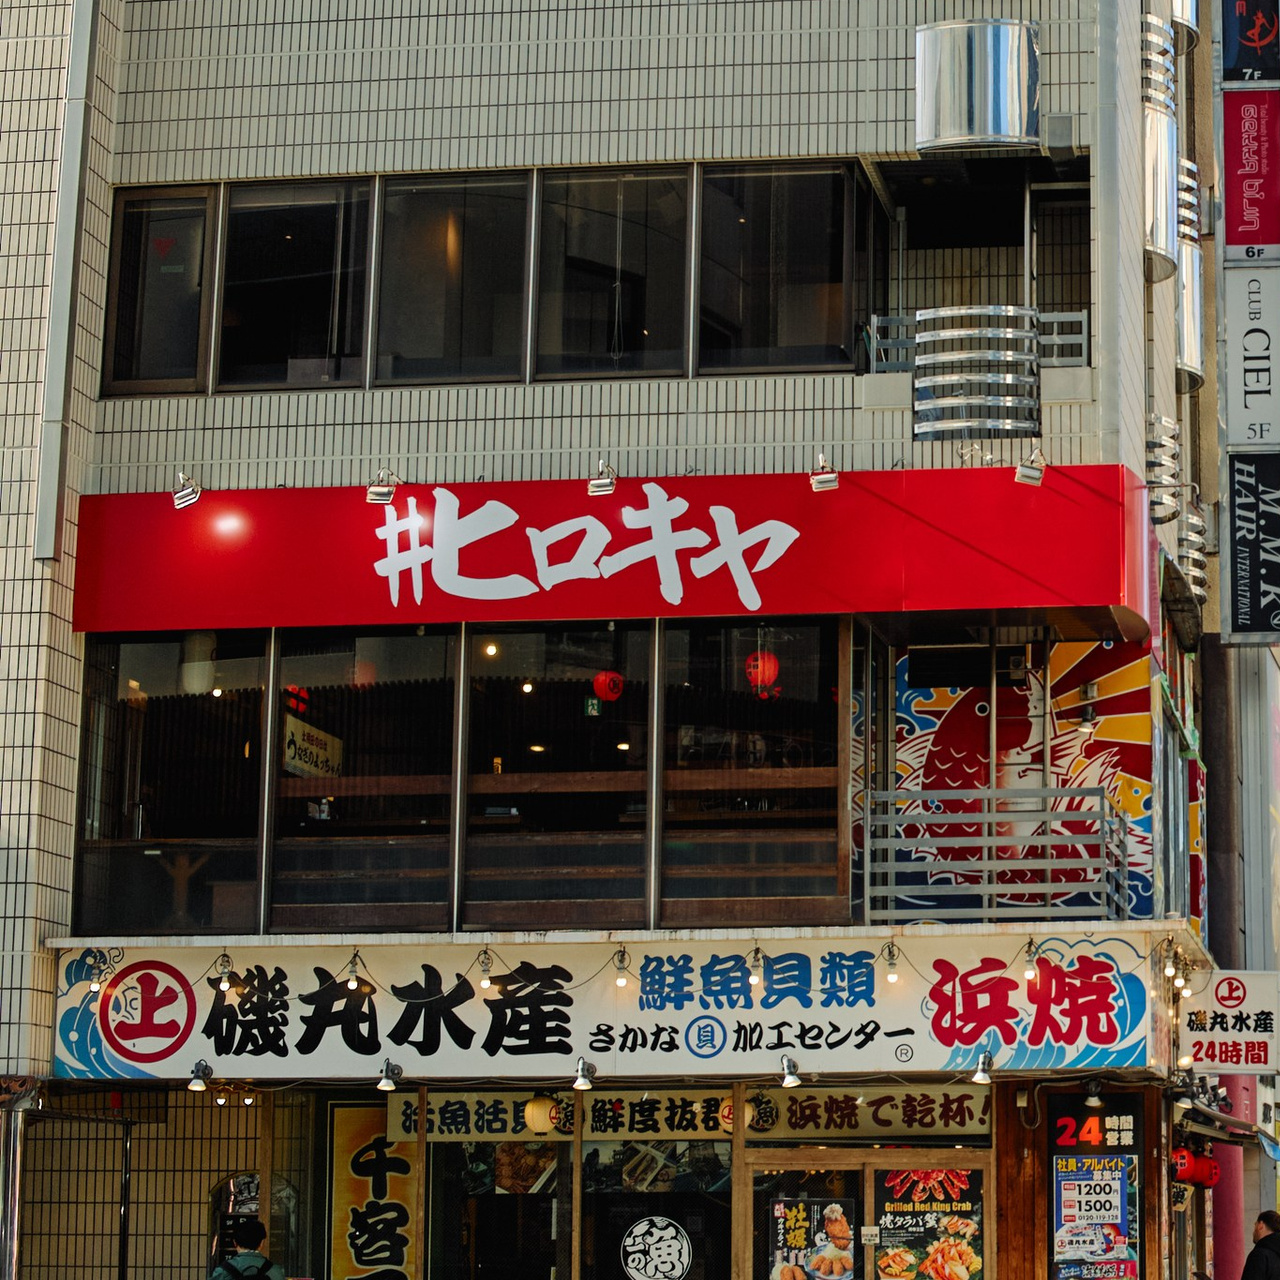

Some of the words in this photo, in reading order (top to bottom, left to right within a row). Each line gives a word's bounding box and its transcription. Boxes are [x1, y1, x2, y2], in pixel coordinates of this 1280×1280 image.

[1242, 68, 1262, 81] 7F
[1246, 245, 1265, 259] 6F
[1247, 278, 1262, 321] CLUB
[1242, 328, 1273, 410] CIEL
[1246, 422, 1271, 440] 5F
[1235, 461, 1257, 541] HAIR
[1237, 545, 1251, 626] INTERNATIONAL
[638, 949, 876, 1013] 鮮魚貝類
[201, 959, 575, 1058] 磯丸水産
[928, 954, 1122, 1050] 浜焼
[1186, 1008, 1275, 1035] 磯丸水産
[1191, 1040, 1269, 1066] 24時間
[1056, 1116, 1103, 1146] 24
[1057, 1158, 1126, 1172] 社員・アルバイト
[1092, 1170, 1122, 1181] 募集中
[885, 1202, 913, 1212] Grilled
[914, 1202, 930, 1211] Red
[932, 1202, 951, 1213] King
[952, 1201, 972, 1211] Crab
